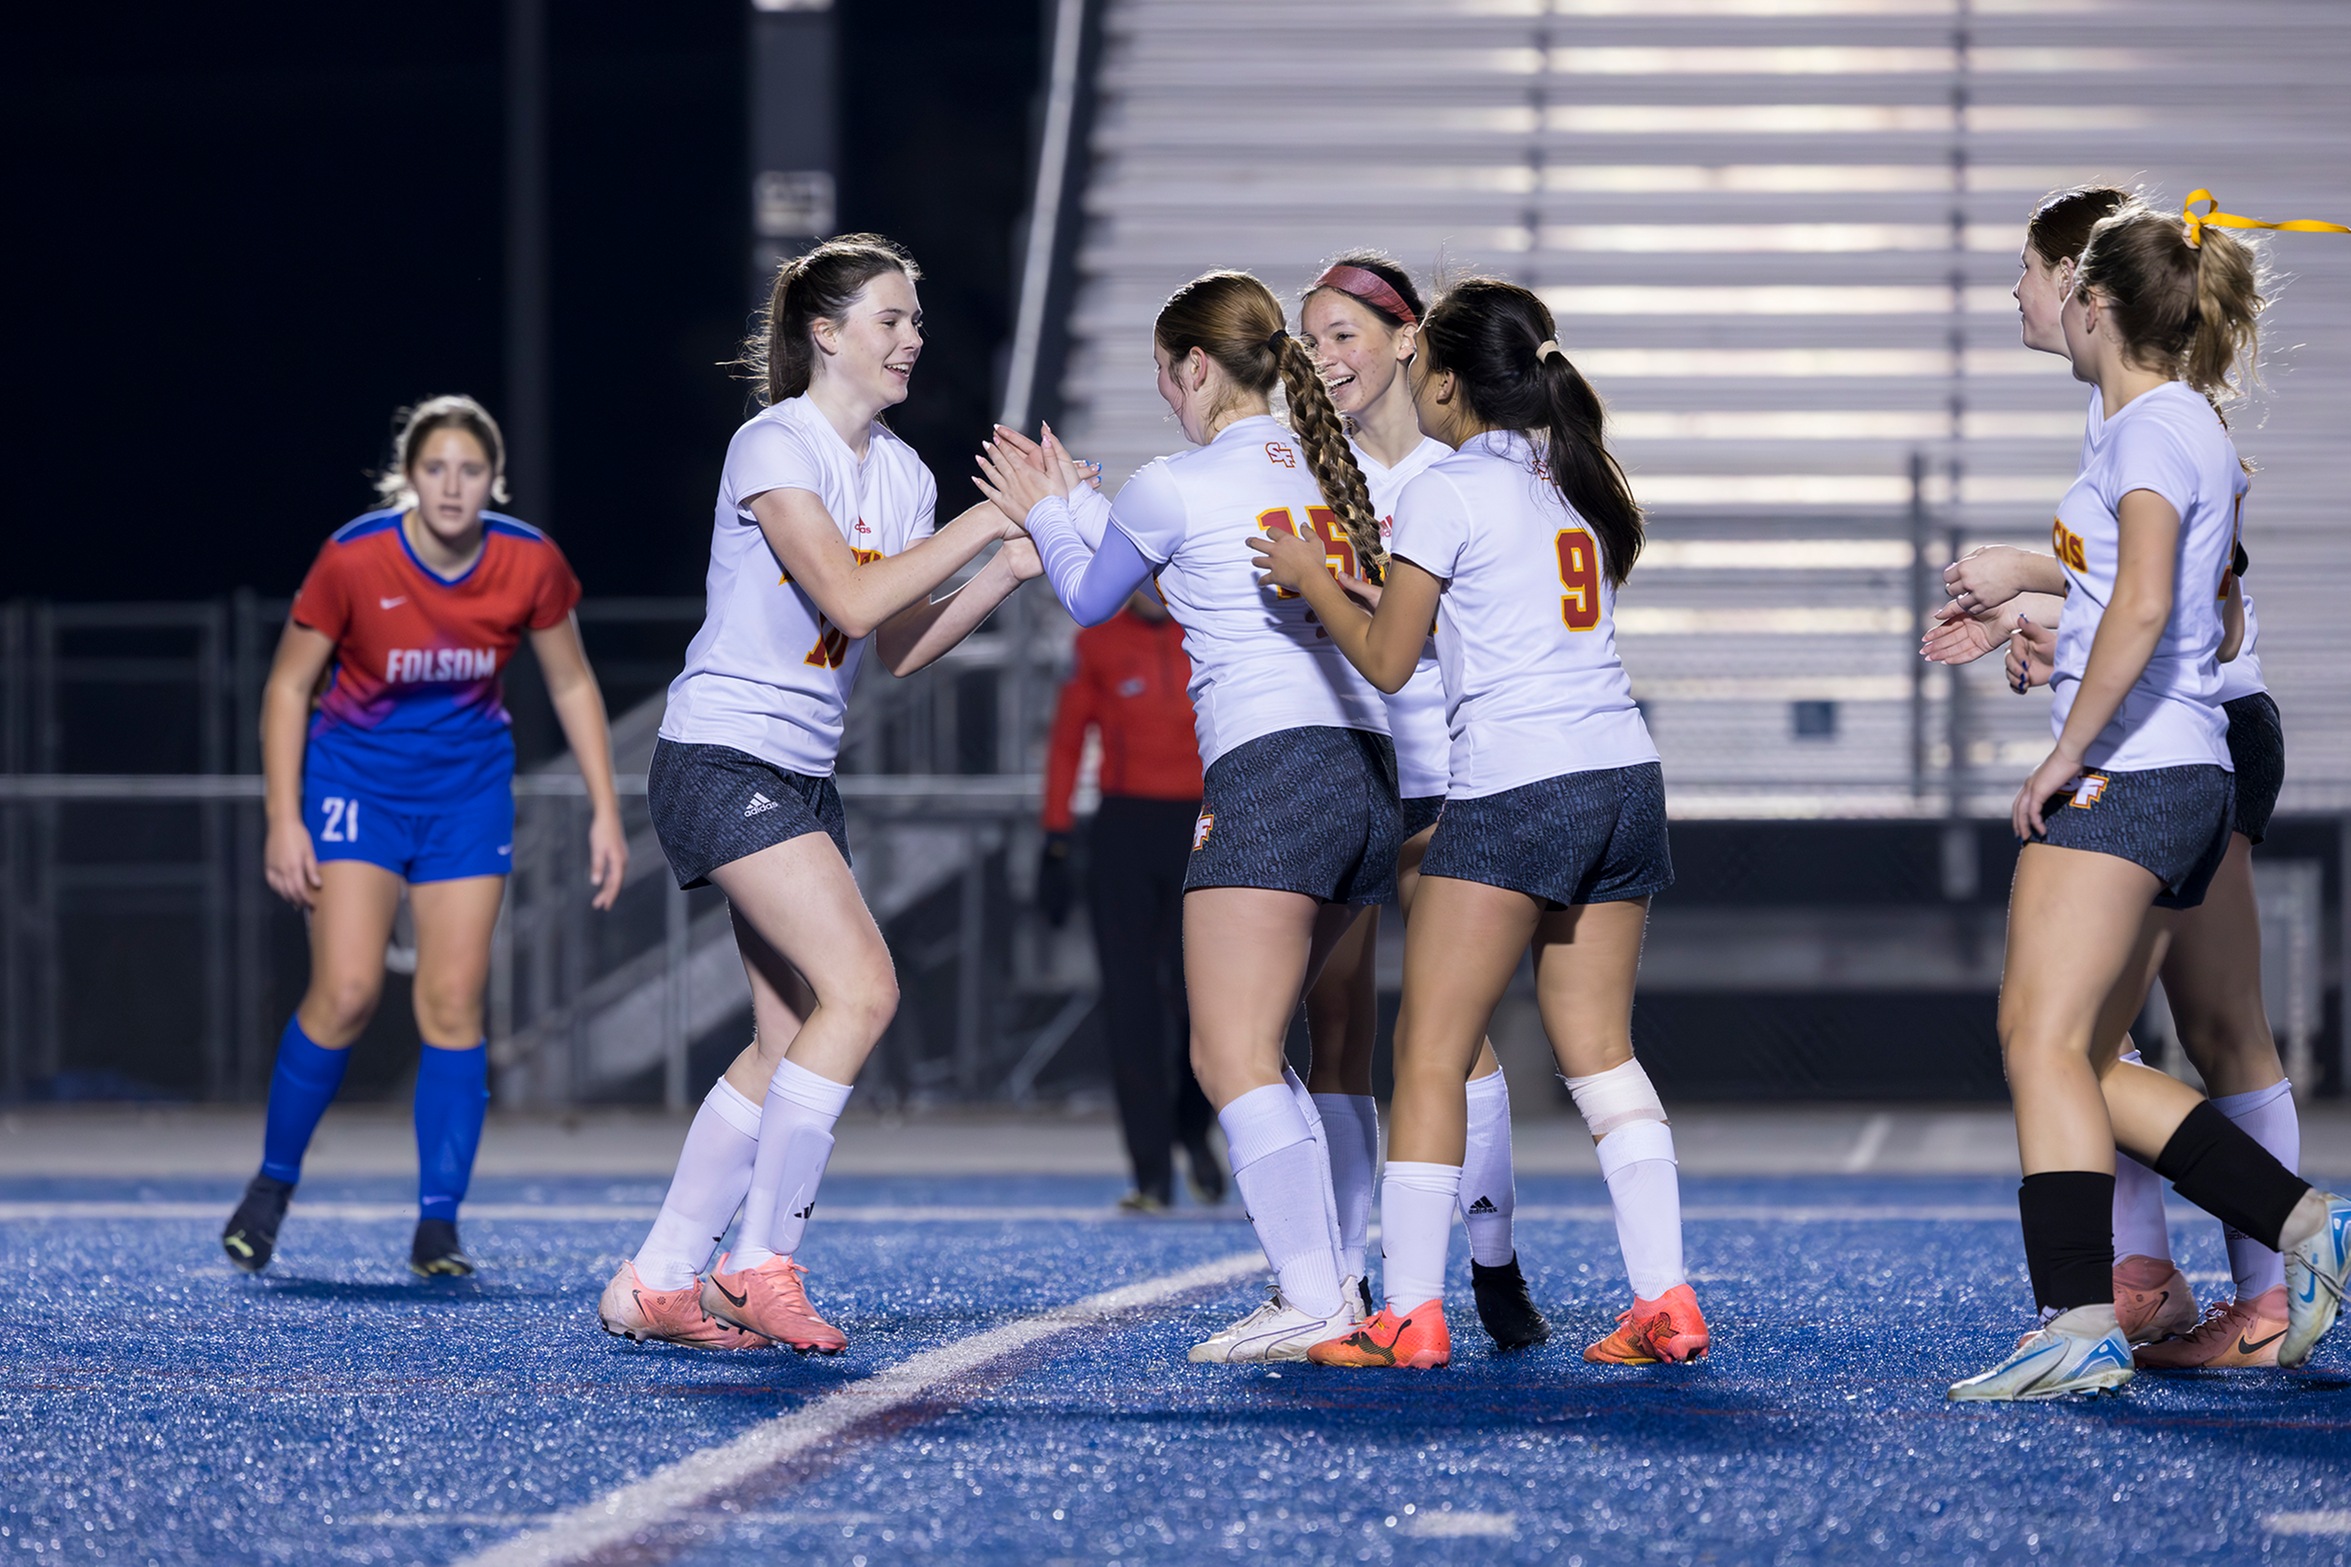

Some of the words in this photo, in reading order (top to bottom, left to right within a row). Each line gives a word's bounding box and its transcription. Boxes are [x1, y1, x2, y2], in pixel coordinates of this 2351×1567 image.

[1265, 441, 1296, 468] SF
[1554, 528, 1601, 632] 9
[386, 646, 497, 684] FOLSOM
[320, 796, 359, 843] 21
[744, 801, 778, 818] adidas
[1468, 1206, 1498, 1215] adidas
